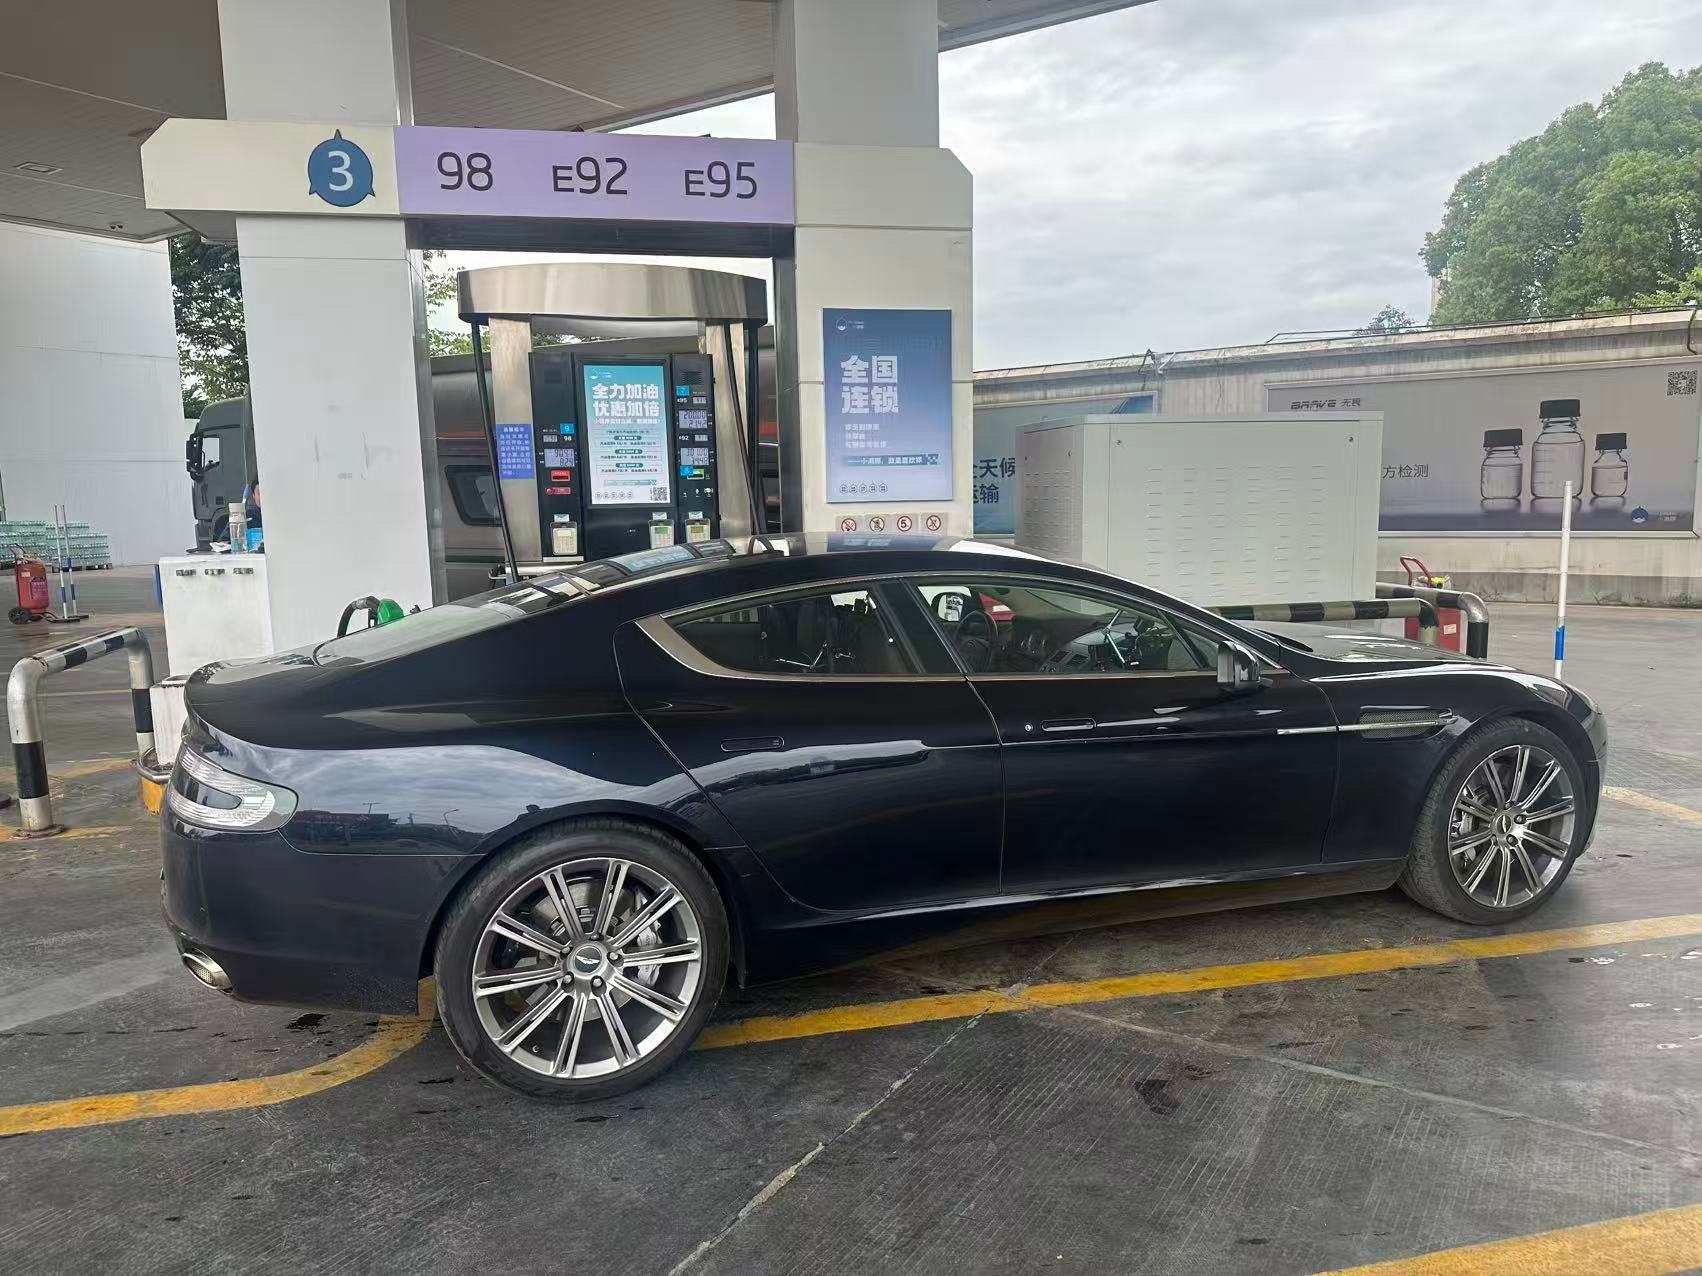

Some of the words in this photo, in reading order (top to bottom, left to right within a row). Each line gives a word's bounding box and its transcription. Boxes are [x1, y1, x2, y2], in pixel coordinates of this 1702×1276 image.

[327, 151, 353, 192] 3
[436, 152, 494, 192] 98
[552, 157, 628, 195] E92
[684, 161, 758, 199] E95
[840, 355, 898, 384] 全国
[591, 383, 659, 399] 全力加油
[841, 385, 899, 414] 连锁
[593, 400, 660, 417] 优惠加倍
[1290, 399, 1337, 410] BRAVE
[973, 457, 1016, 478] 天候
[1381, 463, 1429, 478] 方检测
[900, 519, 907, 528] 5
